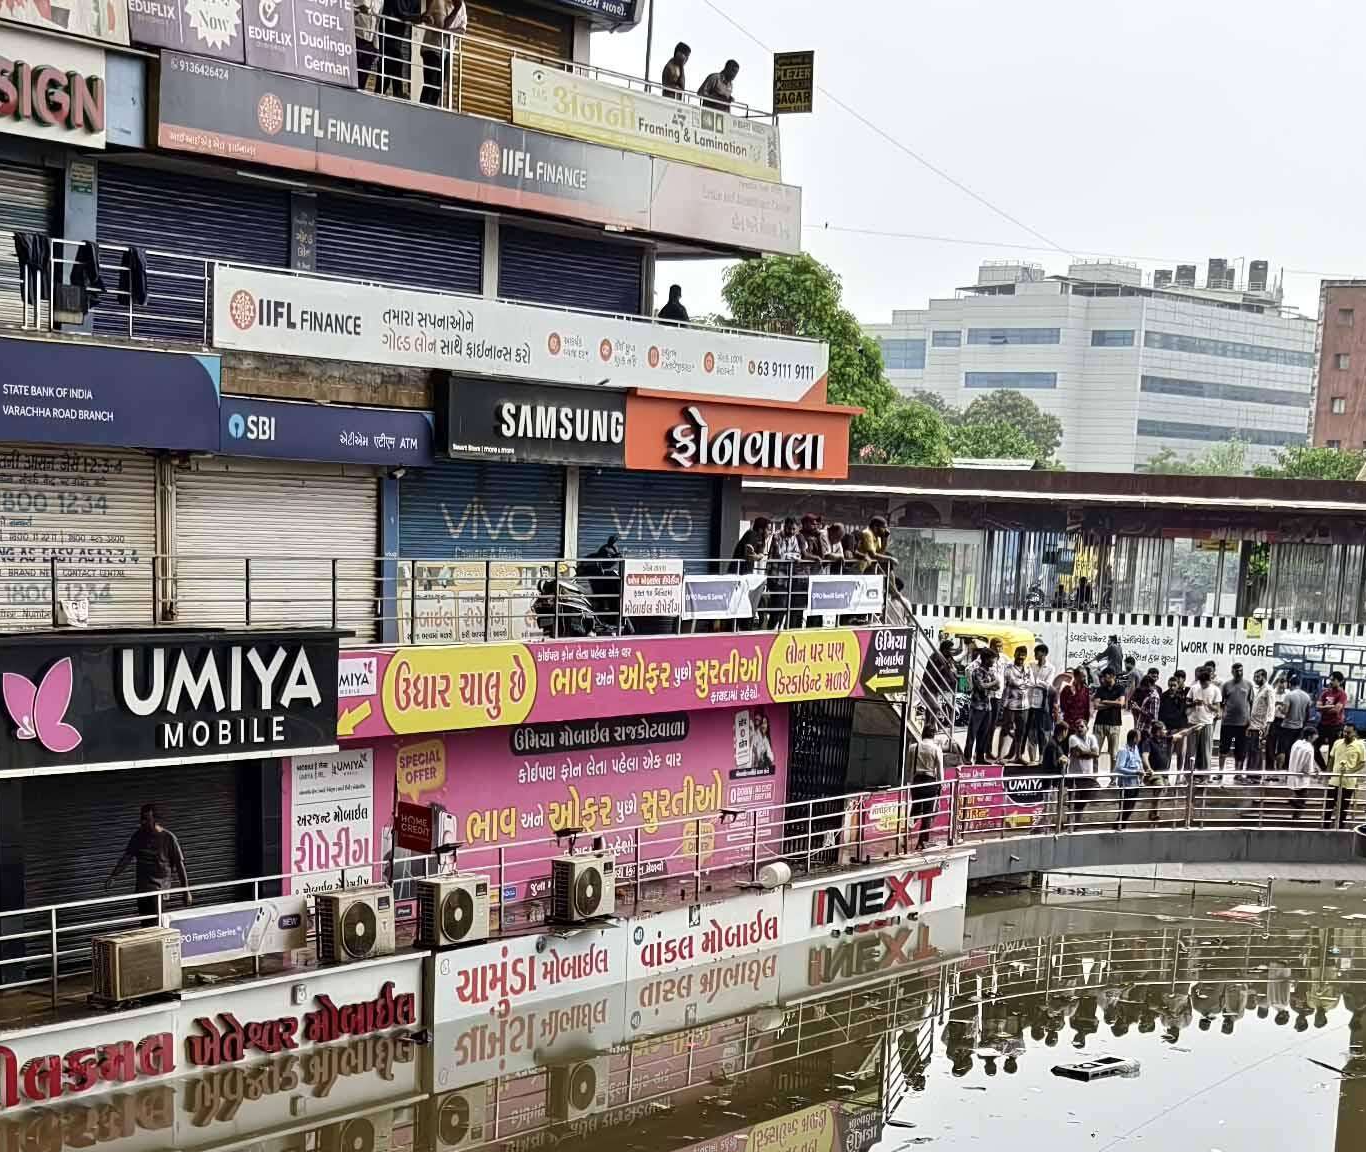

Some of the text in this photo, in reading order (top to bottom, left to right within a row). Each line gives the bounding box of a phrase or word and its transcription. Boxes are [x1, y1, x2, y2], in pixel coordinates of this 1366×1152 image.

[199, 10, 230, 32] Now
[306, 10, 344, 31] TOEFL
[248, 27, 292, 46] EDUFLIX
[299, 31, 352, 56] Duolingo
[304, 55, 351, 76] German
[286, 103, 390, 151] IIFL FINANCE
[638, 117, 748, 157] Framing Lamination
[502, 148, 587, 190] IIFL FINANCE
[259, 297, 362, 337] IIFL FINANCE
[382, 308, 474, 333] તમારા સપનાઓને
[382, 328, 531, 365] ગોલ્ડ લોન સાથે ફાઈનાન્સ કરો
[757, 362, 769, 377] 63
[772, 362, 792, 379] 9111
[795, 365, 815, 381] 9111
[3, 384, 93, 400] STATE BANK OF INDIA
[3, 405, 114, 422] VARACHHA ROAD BRANCH
[501, 402, 625, 443] SAMSUNG
[247, 415, 275, 440] SBI
[340, 431, 369, 447] એટીએમ
[669, 406, 827, 470] ફોનવાલા
[400, 437, 418, 449] ATM
[786, 636, 845, 664] લોન પર પણ
[875, 631, 907, 650] ઉમિયા
[1181, 641, 1224, 654] WORK IN
[875, 651, 904, 666] મોબાઈલ
[121, 646, 322, 715] UMIYA
[550, 646, 762, 698] ભાવ અને ઓફર સુરતીઓ
[825, 663, 850, 691] મળશે
[394, 655, 526, 720] ઉધાર ચાલુ છે
[163, 716, 285, 749] MOBILE
[514, 718, 685, 751] ઉમિયા મોબાઈલ રાજકોટવાળા
[337, 759, 365, 772] UMIYA
[399, 749, 441, 770] SPECIAL
[518, 749, 682, 784] કોઈપણ ફોન લેતા પહેલા એક વાર
[405, 767, 438, 784] OFFER
[297, 803, 368, 827] અરજન્ટ મોબાઈલ
[466, 771, 723, 845] ભાવ અને ઓફર સુરતીઓ
[400, 823, 431, 837] CREDIT
[401, 815, 428, 828] HOME
[640, 915, 778, 968] વાંકલ મોબાઈલ
[541, 949, 608, 985] મોબાઈલ
[304, 980, 416, 1044] મોબાઈલ
